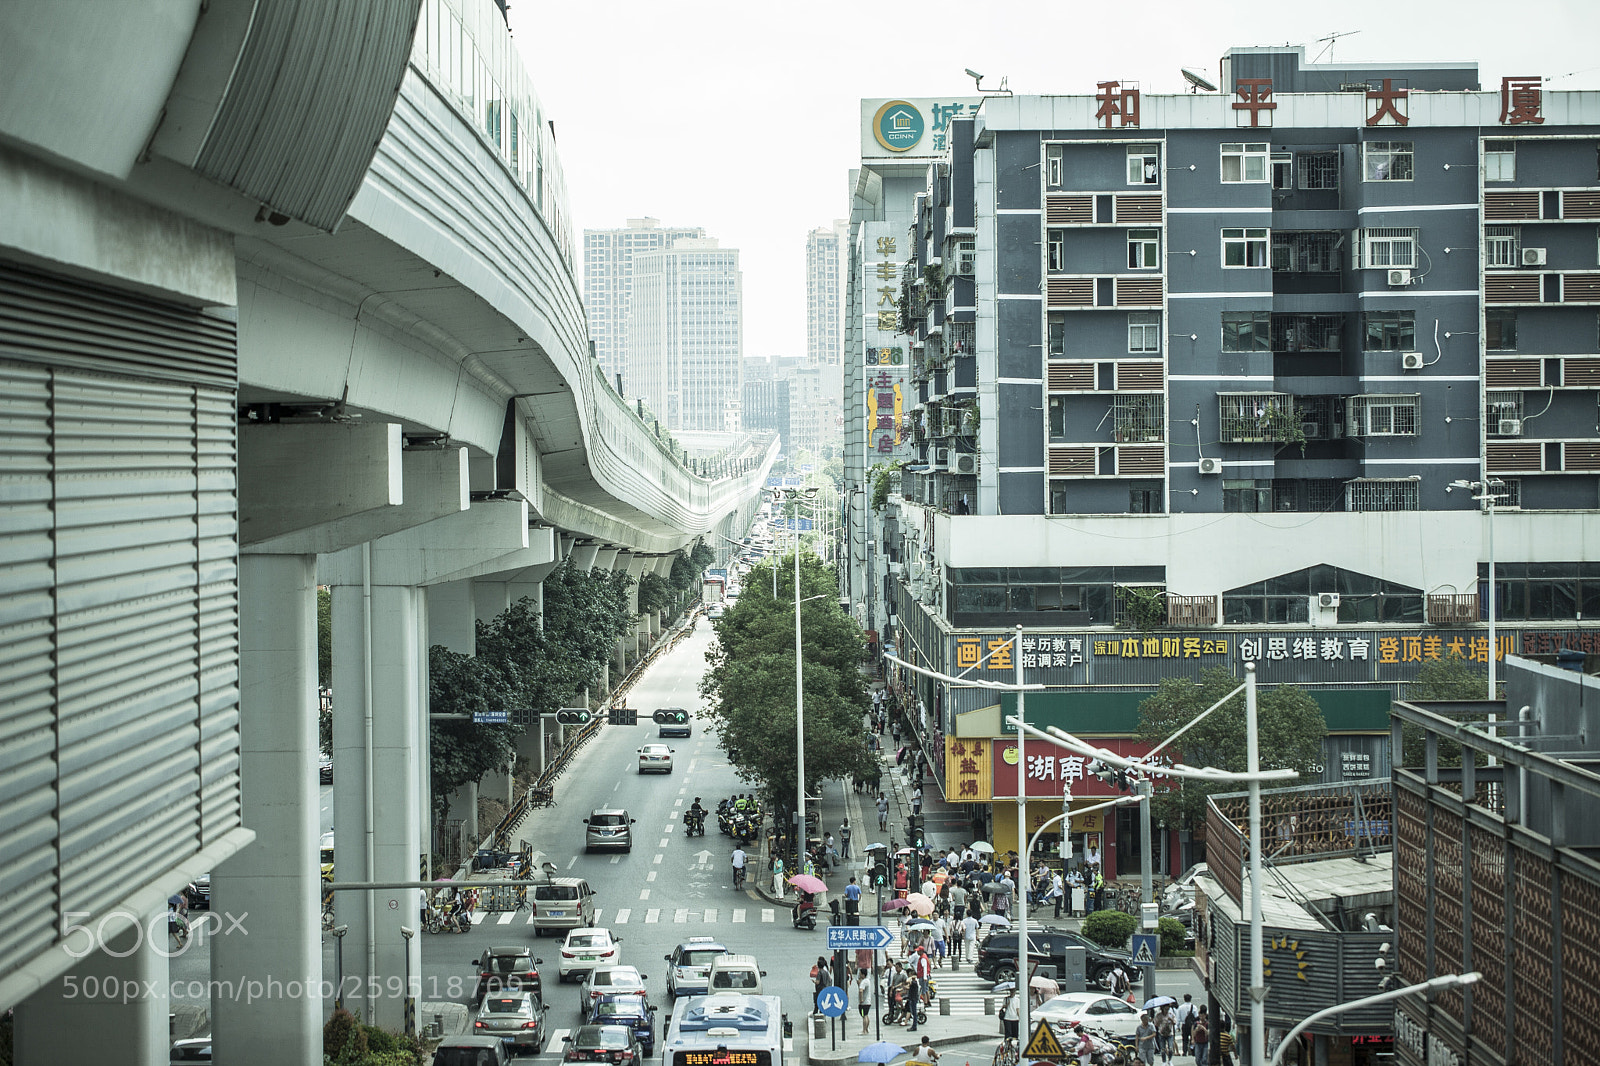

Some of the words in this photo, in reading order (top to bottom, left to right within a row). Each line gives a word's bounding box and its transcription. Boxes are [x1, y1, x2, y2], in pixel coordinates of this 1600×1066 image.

[1095, 77, 1545, 128] 和平大厦
[931, 102, 980, 132] 城
[877, 370, 894, 453] 主题酒店
[957, 637, 1013, 670] 画室
[1022, 637, 1083, 653] 学历教育
[1094, 637, 1228, 658] 深圳本地财务公司
[1239, 637, 1371, 661] 创思维教育
[1379, 635, 1515, 664] 登顶美术培训
[1022, 653, 1084, 668] 招调深户
[1027, 754, 1174, 782] 湖南粉
[1033, 814, 1097, 829] 盐店
